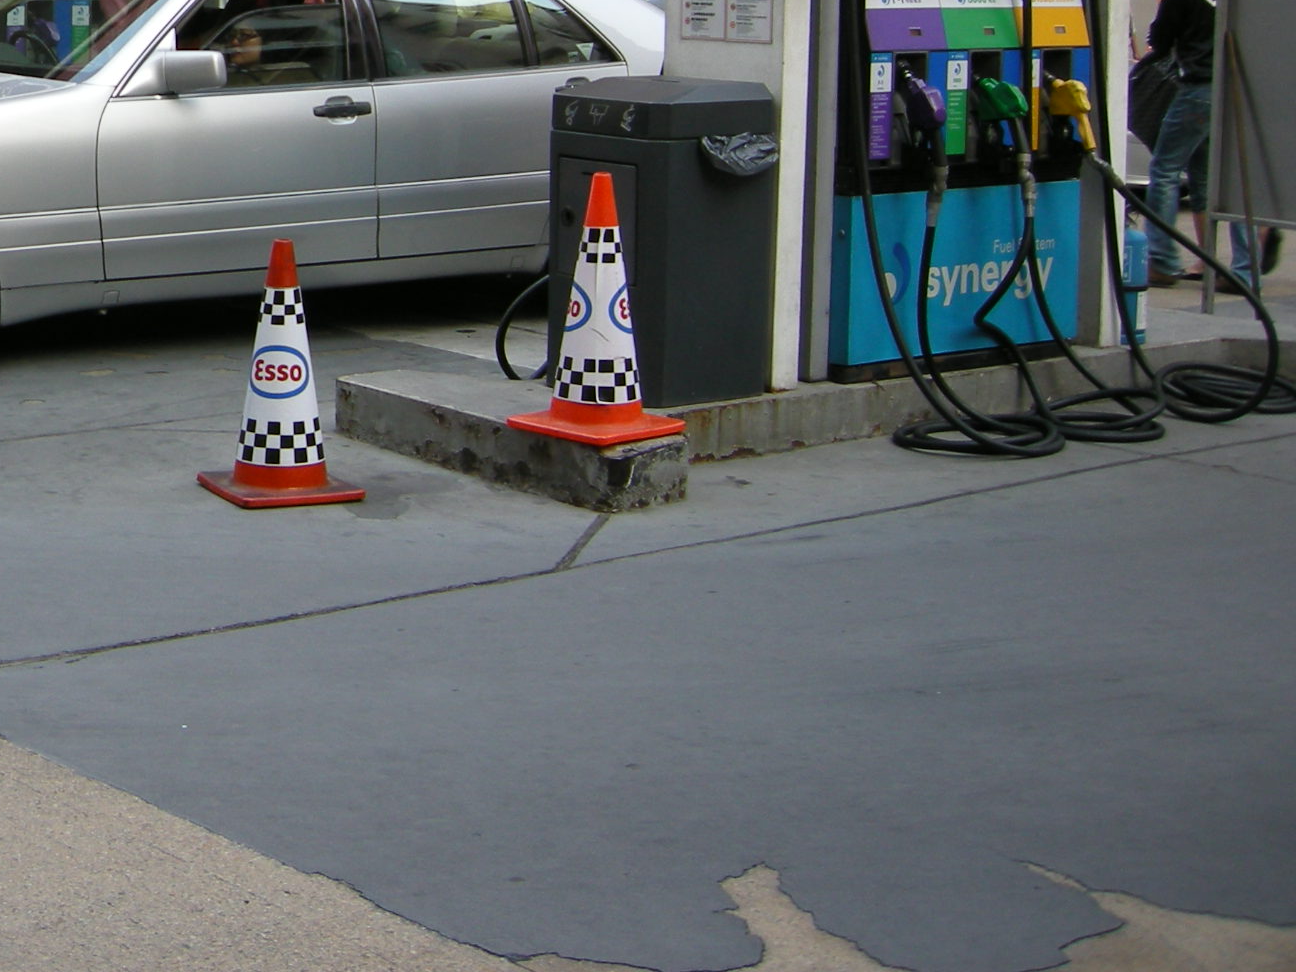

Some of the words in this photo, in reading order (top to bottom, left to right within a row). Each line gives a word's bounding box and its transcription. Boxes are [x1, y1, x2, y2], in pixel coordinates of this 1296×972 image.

[993, 239, 1014, 254] Fuel
[1016, 237, 1055, 254] Stem
[927, 255, 1053, 307] synergy
